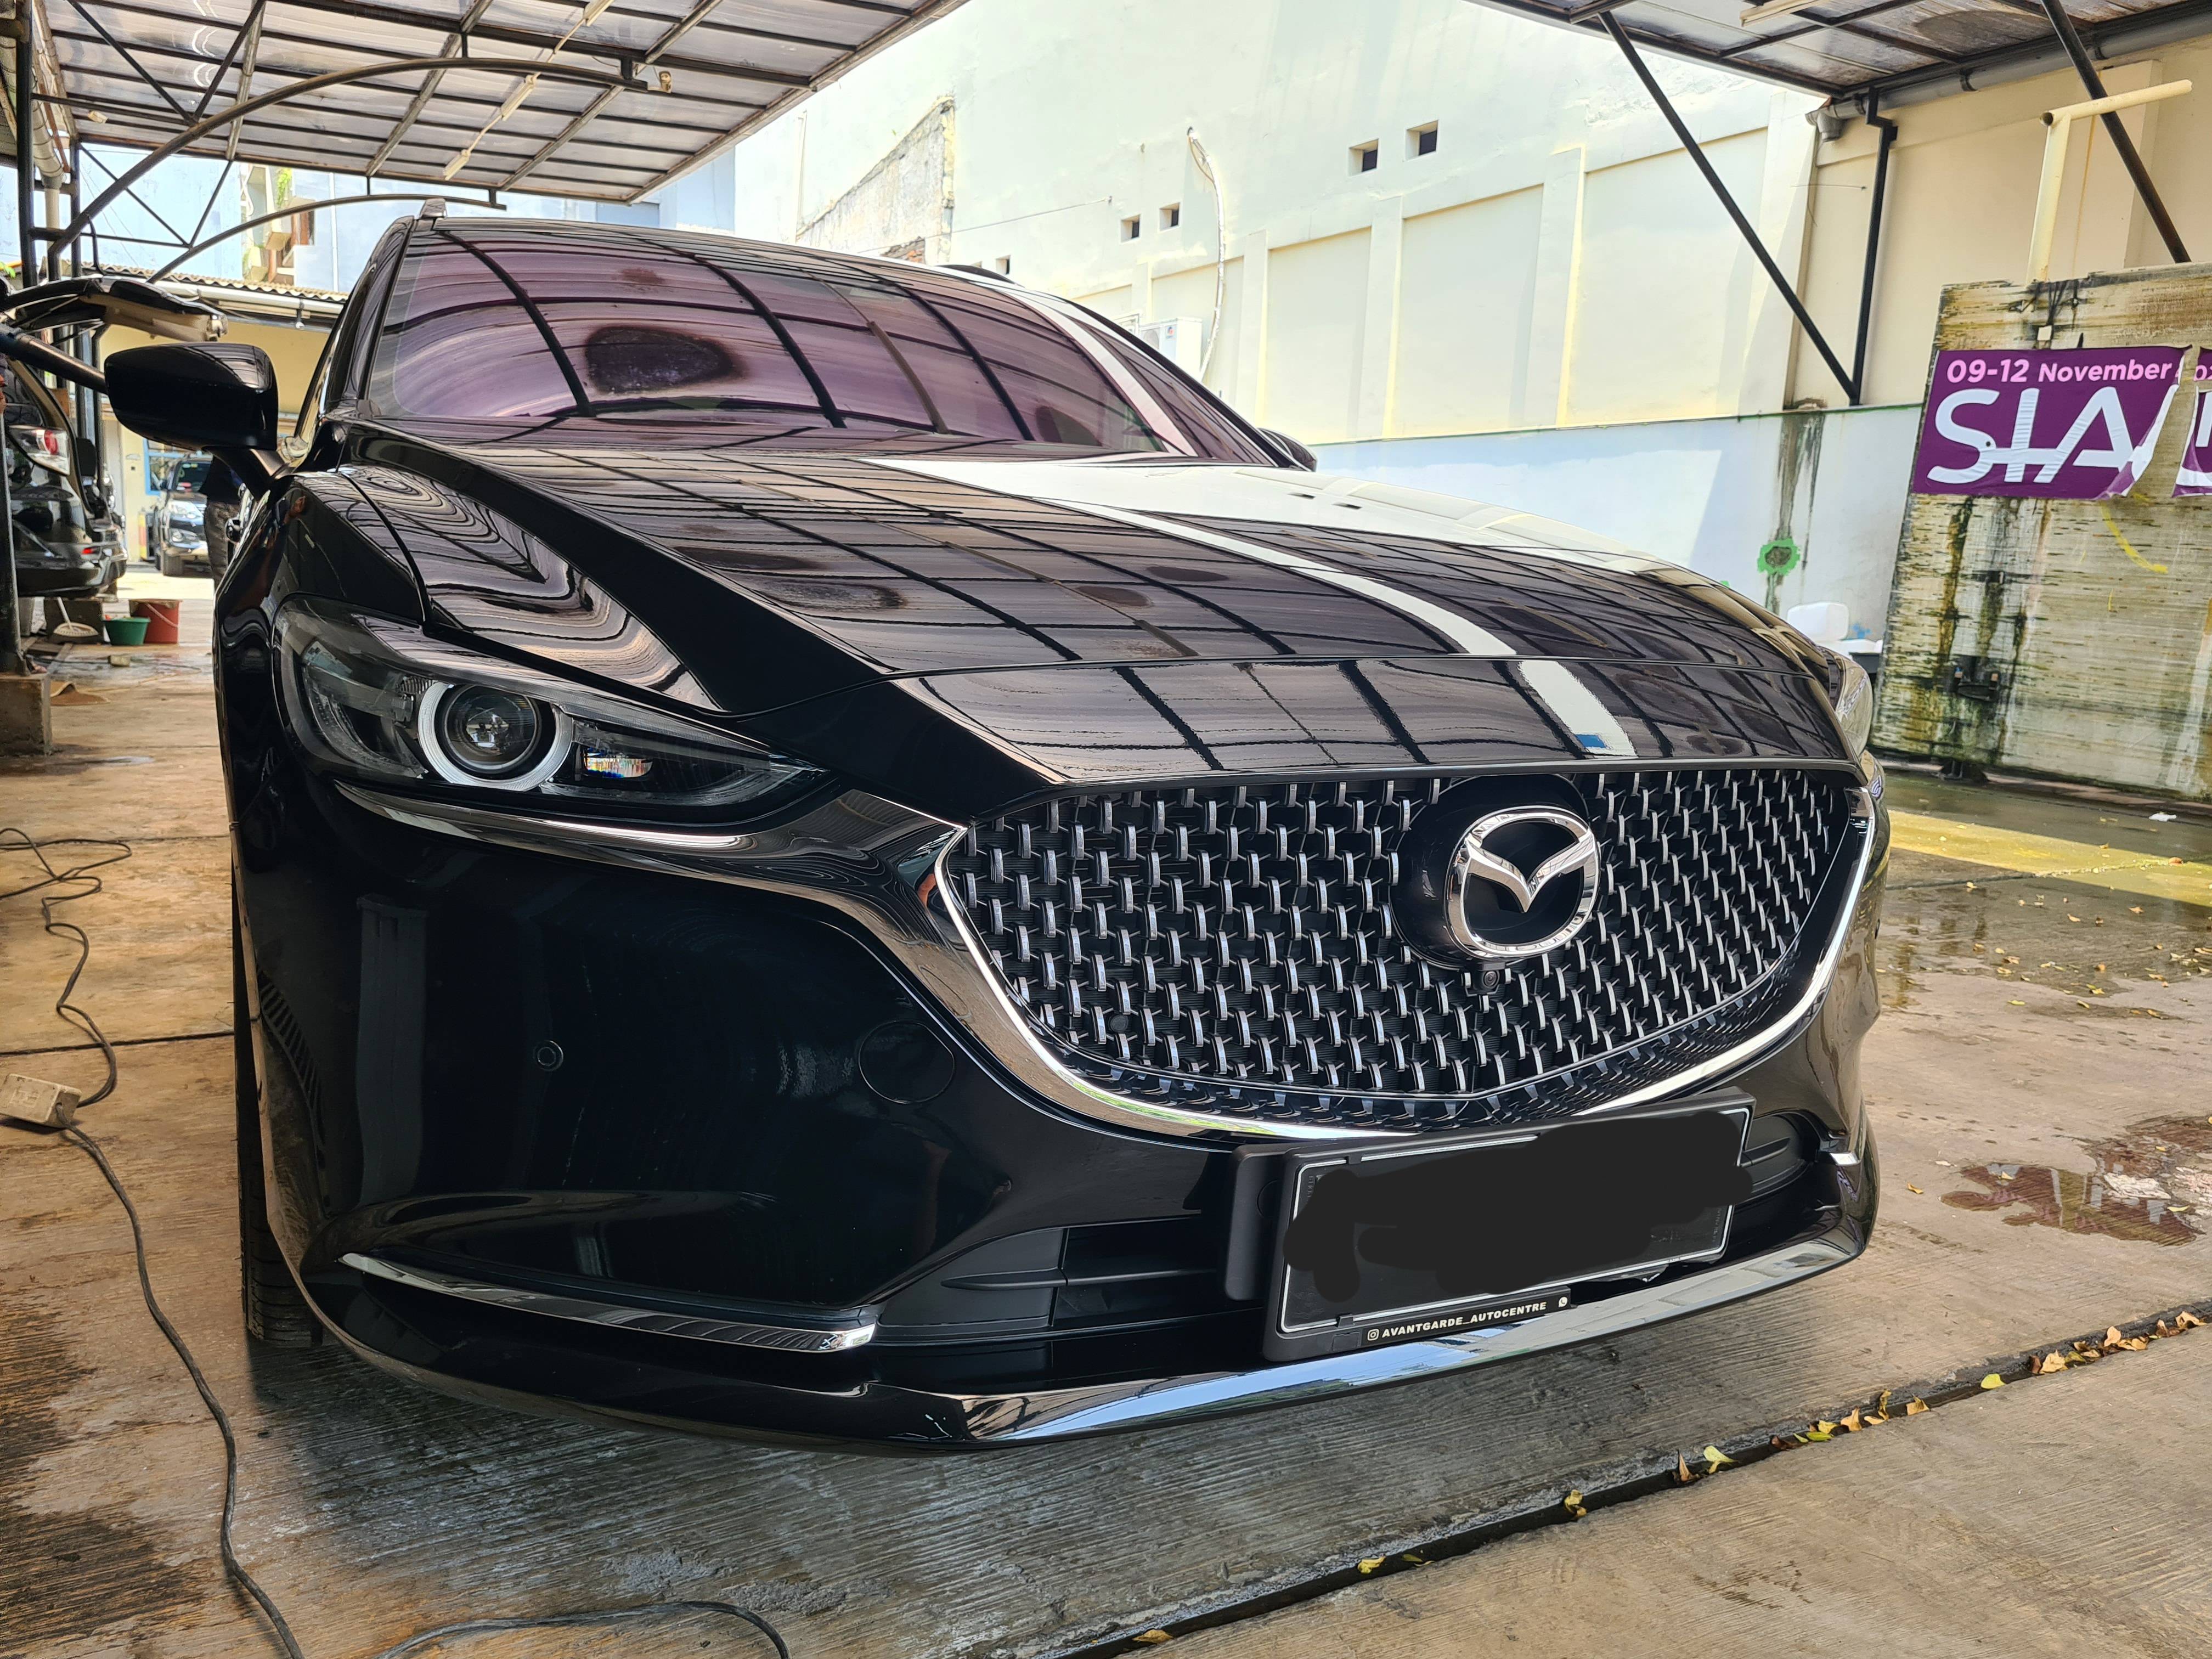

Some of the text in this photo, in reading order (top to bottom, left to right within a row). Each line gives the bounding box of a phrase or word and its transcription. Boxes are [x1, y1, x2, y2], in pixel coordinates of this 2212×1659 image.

[1946, 358, 2029, 383] 09-12
[2038, 359, 2172, 382] November
[1381, 1301, 1547, 1338] AVANTGARDE_AUTOCENTRE
